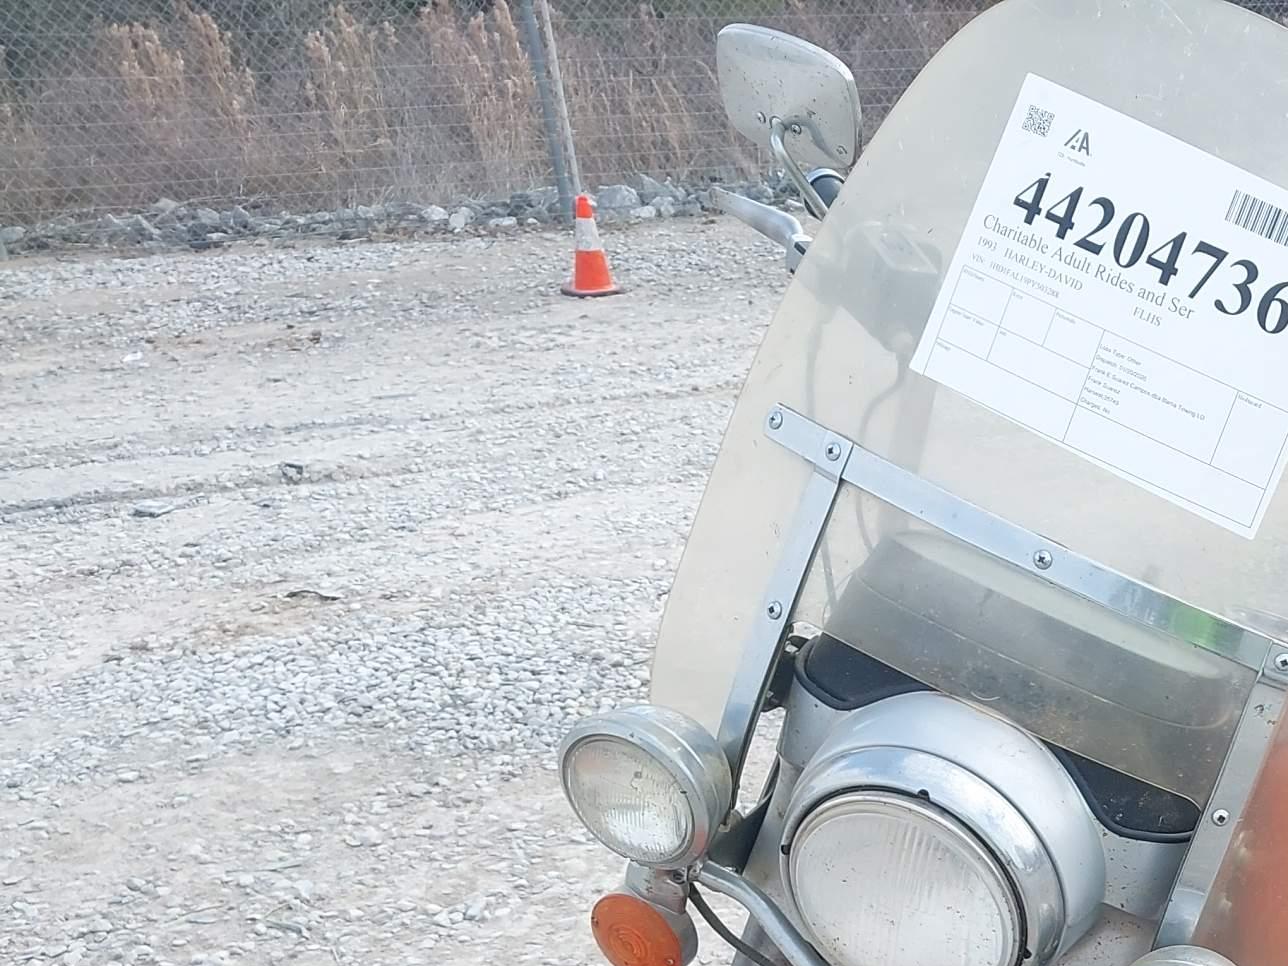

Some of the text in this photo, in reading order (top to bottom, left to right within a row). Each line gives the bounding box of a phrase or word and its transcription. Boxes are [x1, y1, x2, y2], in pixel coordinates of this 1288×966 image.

[977, 235, 998, 252] 1993
[1003, 247, 1083, 291] HARLEY-DAVID
[983, 214, 1195, 319] Charitable Adult Rides and Ser
[1132, 306, 1162, 327] FLHS
